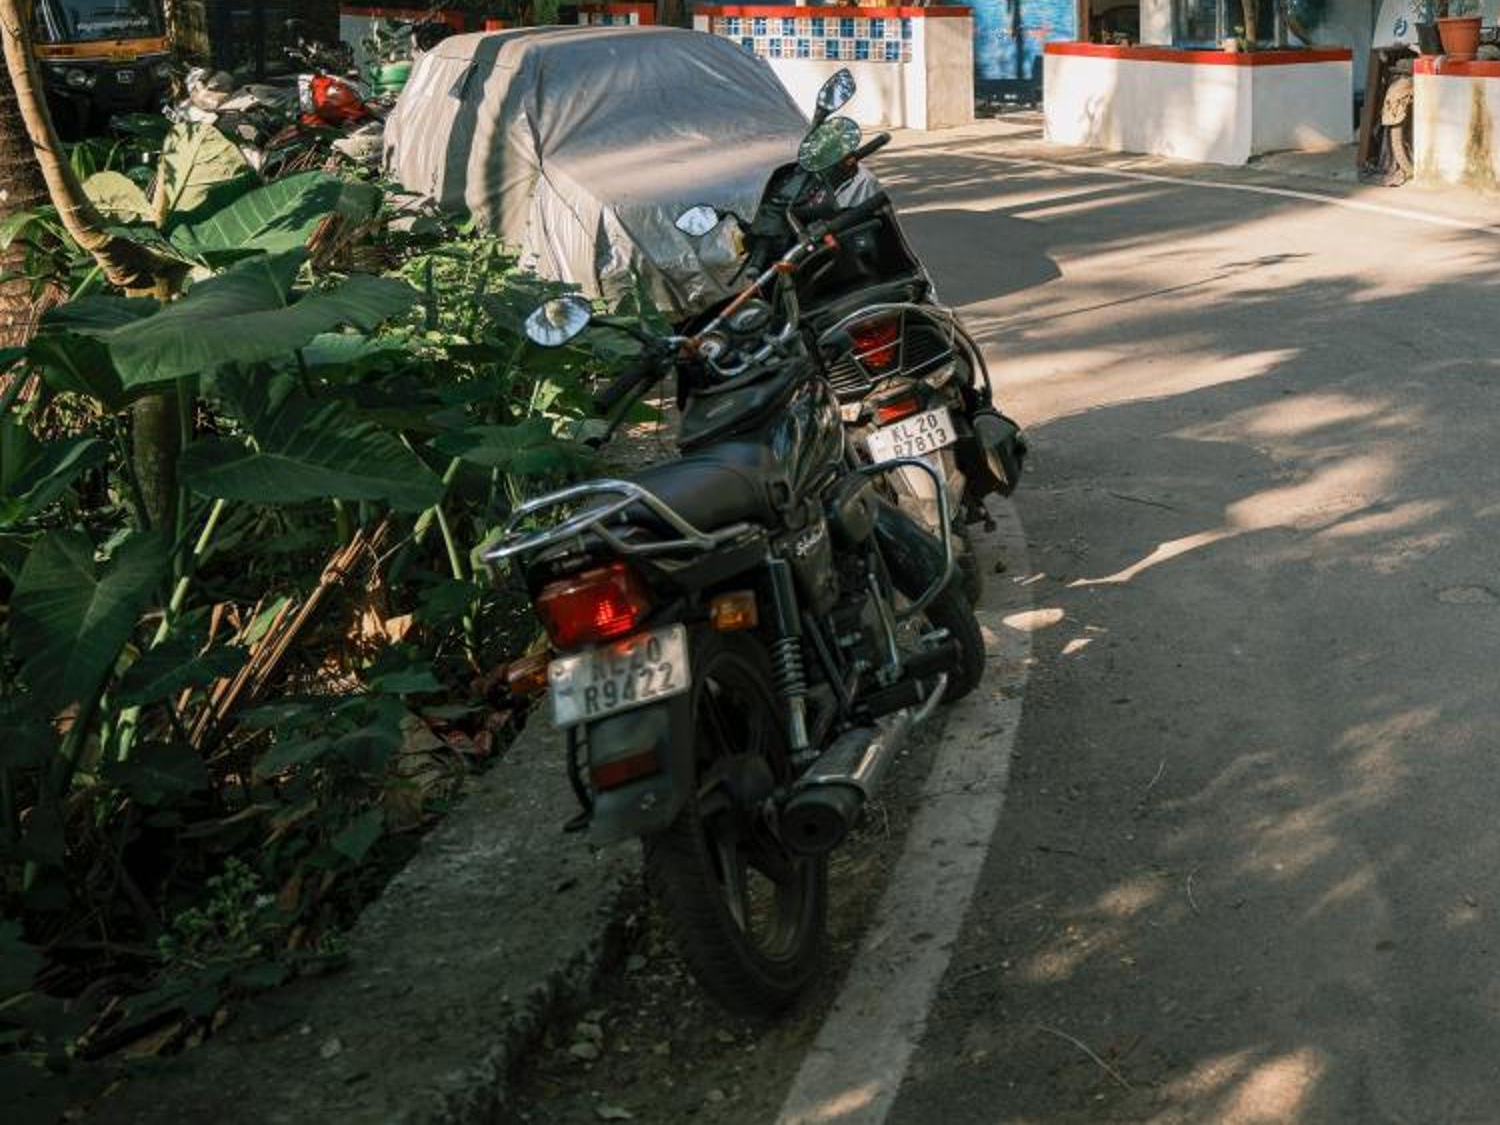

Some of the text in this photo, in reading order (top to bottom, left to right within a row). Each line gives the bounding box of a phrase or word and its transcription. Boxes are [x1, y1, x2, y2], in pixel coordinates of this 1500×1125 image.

[891, 414, 939, 444] KL 20
[893, 428, 947, 458] R7813
